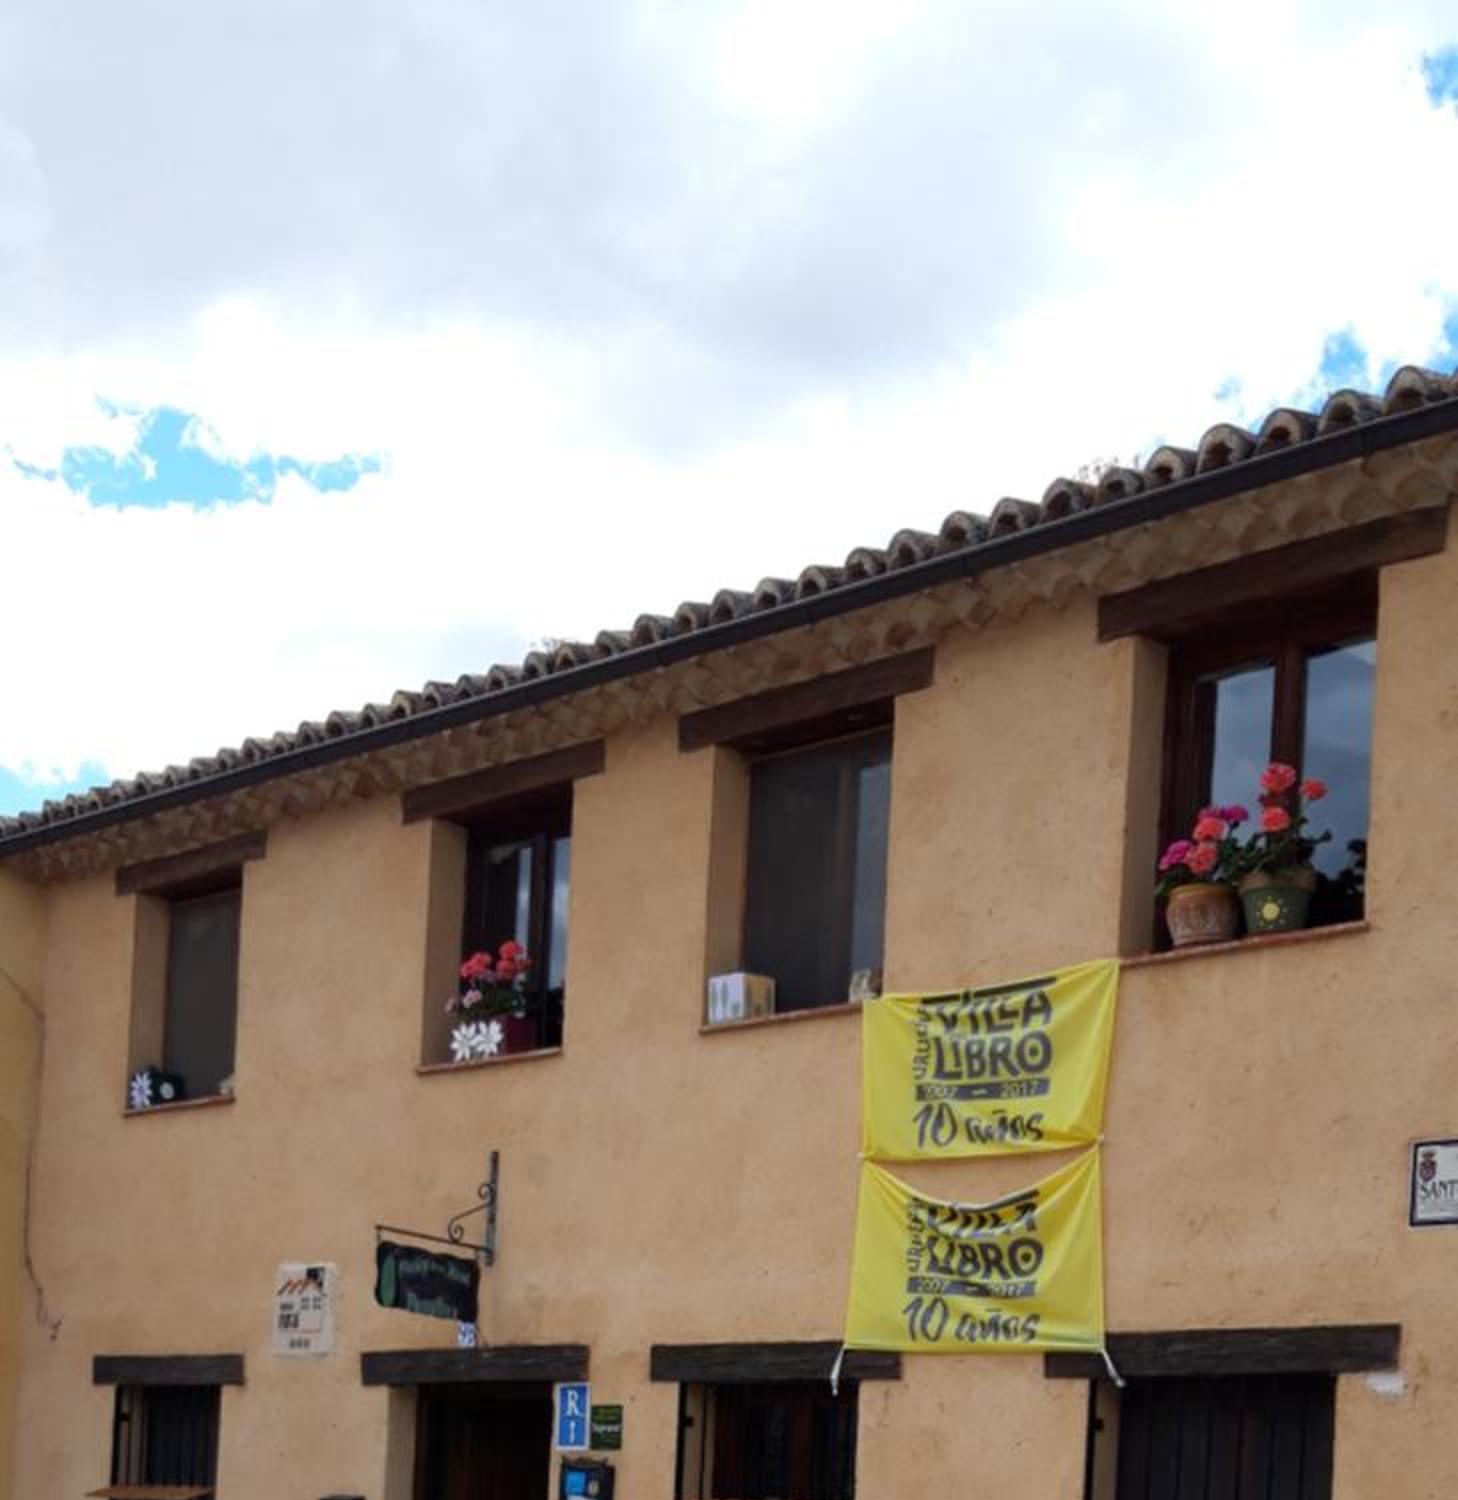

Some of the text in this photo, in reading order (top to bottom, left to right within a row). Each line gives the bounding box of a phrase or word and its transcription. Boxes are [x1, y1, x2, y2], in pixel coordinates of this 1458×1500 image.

[933, 1031, 1053, 1080] LIBRO
[912, 1102, 958, 1148] 10
[927, 1235, 1044, 1281] LIBRO
[902, 1297, 949, 1343] 10
[565, 1390, 583, 1416] R
